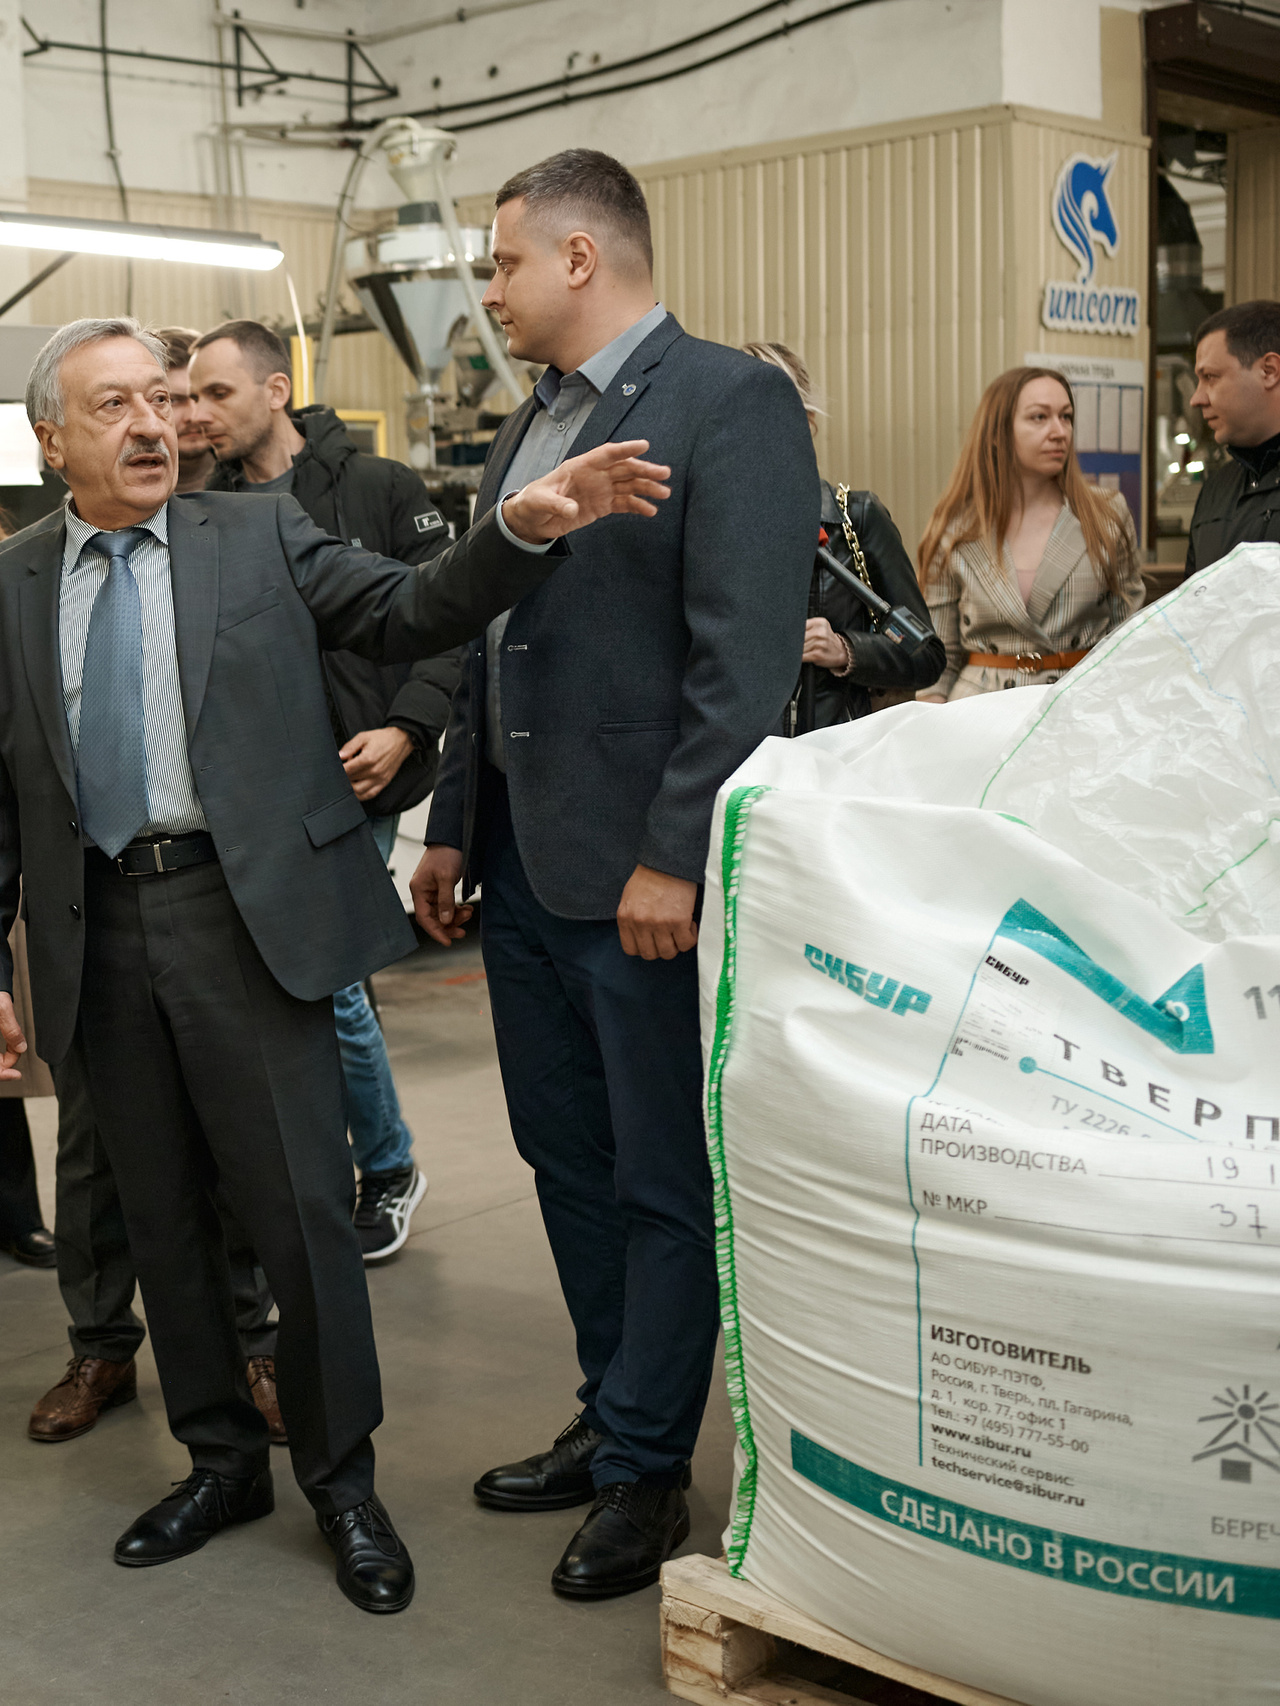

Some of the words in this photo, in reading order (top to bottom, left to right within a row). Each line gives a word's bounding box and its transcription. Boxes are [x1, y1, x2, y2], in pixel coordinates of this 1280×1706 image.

[1048, 287, 1138, 326] unicorn
[803, 942, 934, 1017] СИБУР
[984, 955, 1031, 986] СИБУР
[920, 1112, 974, 1135] ДАТА
[1051, 1095, 1079, 1116] ТУ
[920, 1138, 1088, 1175] ПРОИЗВОДСТВА
[1206, 1156, 1240, 1180] 19
[946, 1194, 988, 1215] МКР
[931, 1324, 1093, 1375] ИЗГОТОВИТЕЛЬ
[931, 1351, 951, 1366] АО
[954, 1357, 1047, 1391] СИБУР-ПЭТФ,
[931, 1369, 978, 1393] Россия,
[980, 1384, 989, 1395] г.
[992, 1384, 1036, 1407] Тверь,
[1038, 1397, 1060, 1411] пл.
[1063, 1400, 1134, 1427] Гагарина,
[931, 1389, 942, 1401] д.
[947, 1390, 957, 1406] 1,
[963, 1397, 991, 1414] кор.
[995, 1402, 1014, 1419] 77,
[1016, 1411, 1055, 1426] офис
[1059, 1417, 1066, 1430] 1
[931, 1423, 1032, 1459] www.sibur.ru
[963, 1414, 978, 1427] +7
[981, 1417, 1015, 1438] (495)
[1018, 1426, 1090, 1454] 777-55-00
[931, 1438, 1018, 1473] Технический
[931, 1456, 1085, 1507] techservice@sibur.ru
[880, 1489, 1033, 1561] СДЕЛАНО
[1042, 1540, 1065, 1571] В
[1074, 1549, 1236, 1604] РОССИИ
